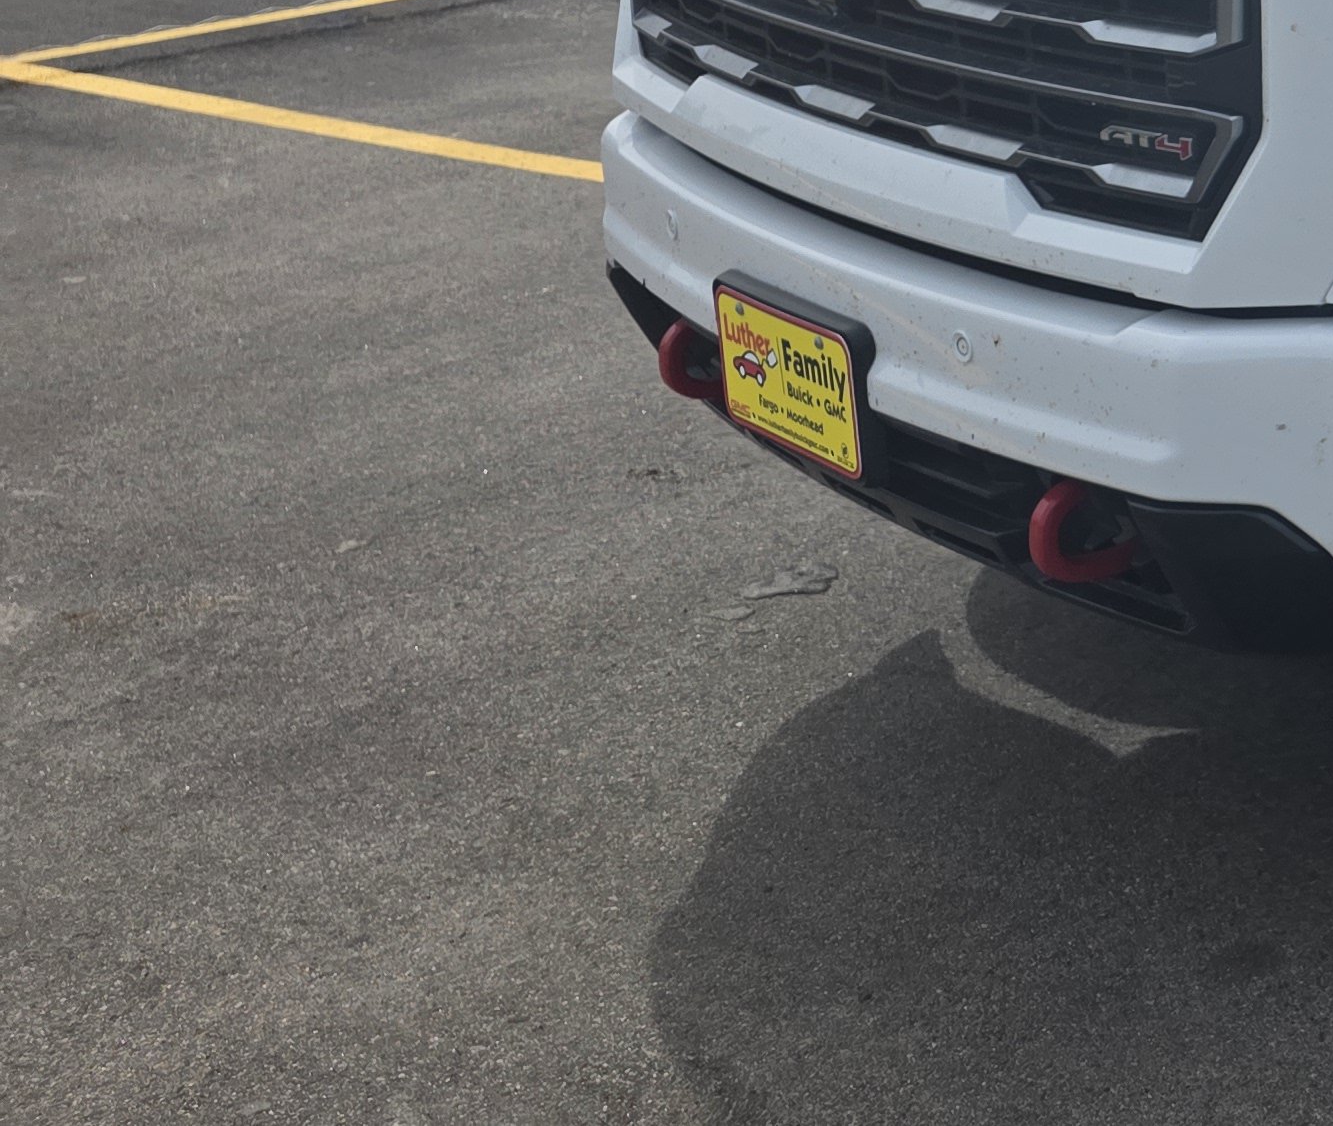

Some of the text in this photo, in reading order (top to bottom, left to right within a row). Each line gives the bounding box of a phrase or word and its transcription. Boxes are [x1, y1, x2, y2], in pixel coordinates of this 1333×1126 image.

[1099, 125, 1193, 161] AT4
[723, 313, 771, 357] Luther
[781, 338, 847, 403] Family
[758, 393, 824, 436] Fargo Moorhead
[786, 381, 847, 423] Buick GMC
